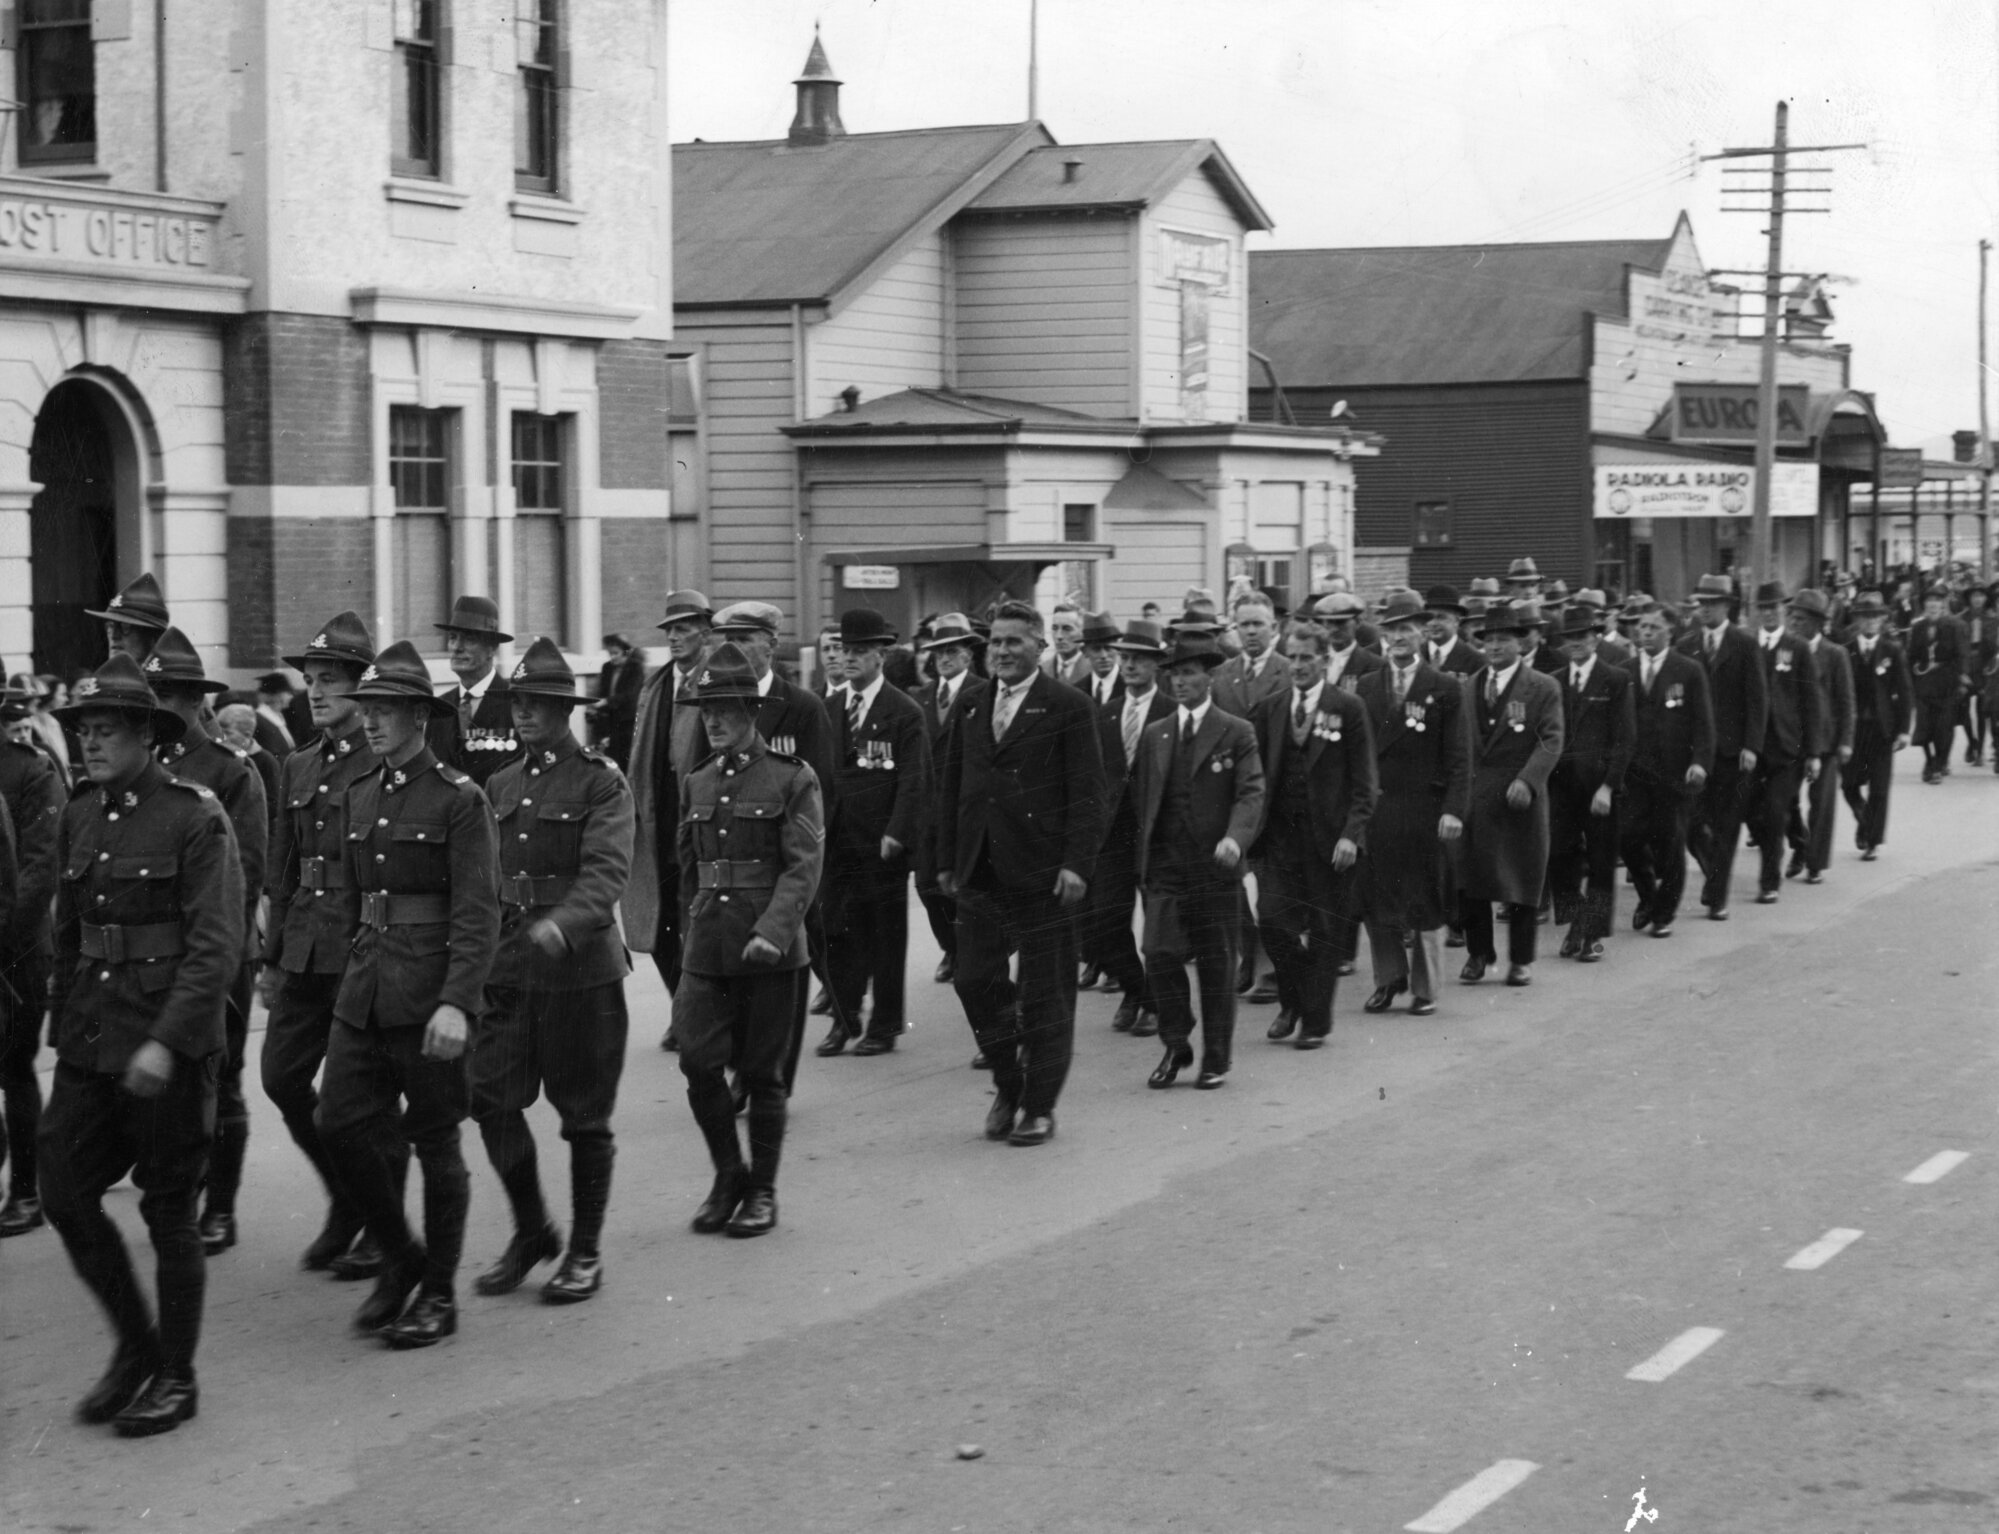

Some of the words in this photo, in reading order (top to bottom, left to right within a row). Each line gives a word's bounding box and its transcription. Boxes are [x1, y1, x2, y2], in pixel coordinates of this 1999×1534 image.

[86, 209, 208, 267] OFFICE
[1680, 396, 1805, 432] EUROA
[1607, 472, 1688, 487] RADIOLA
[1695, 472, 1749, 487] RADIO
